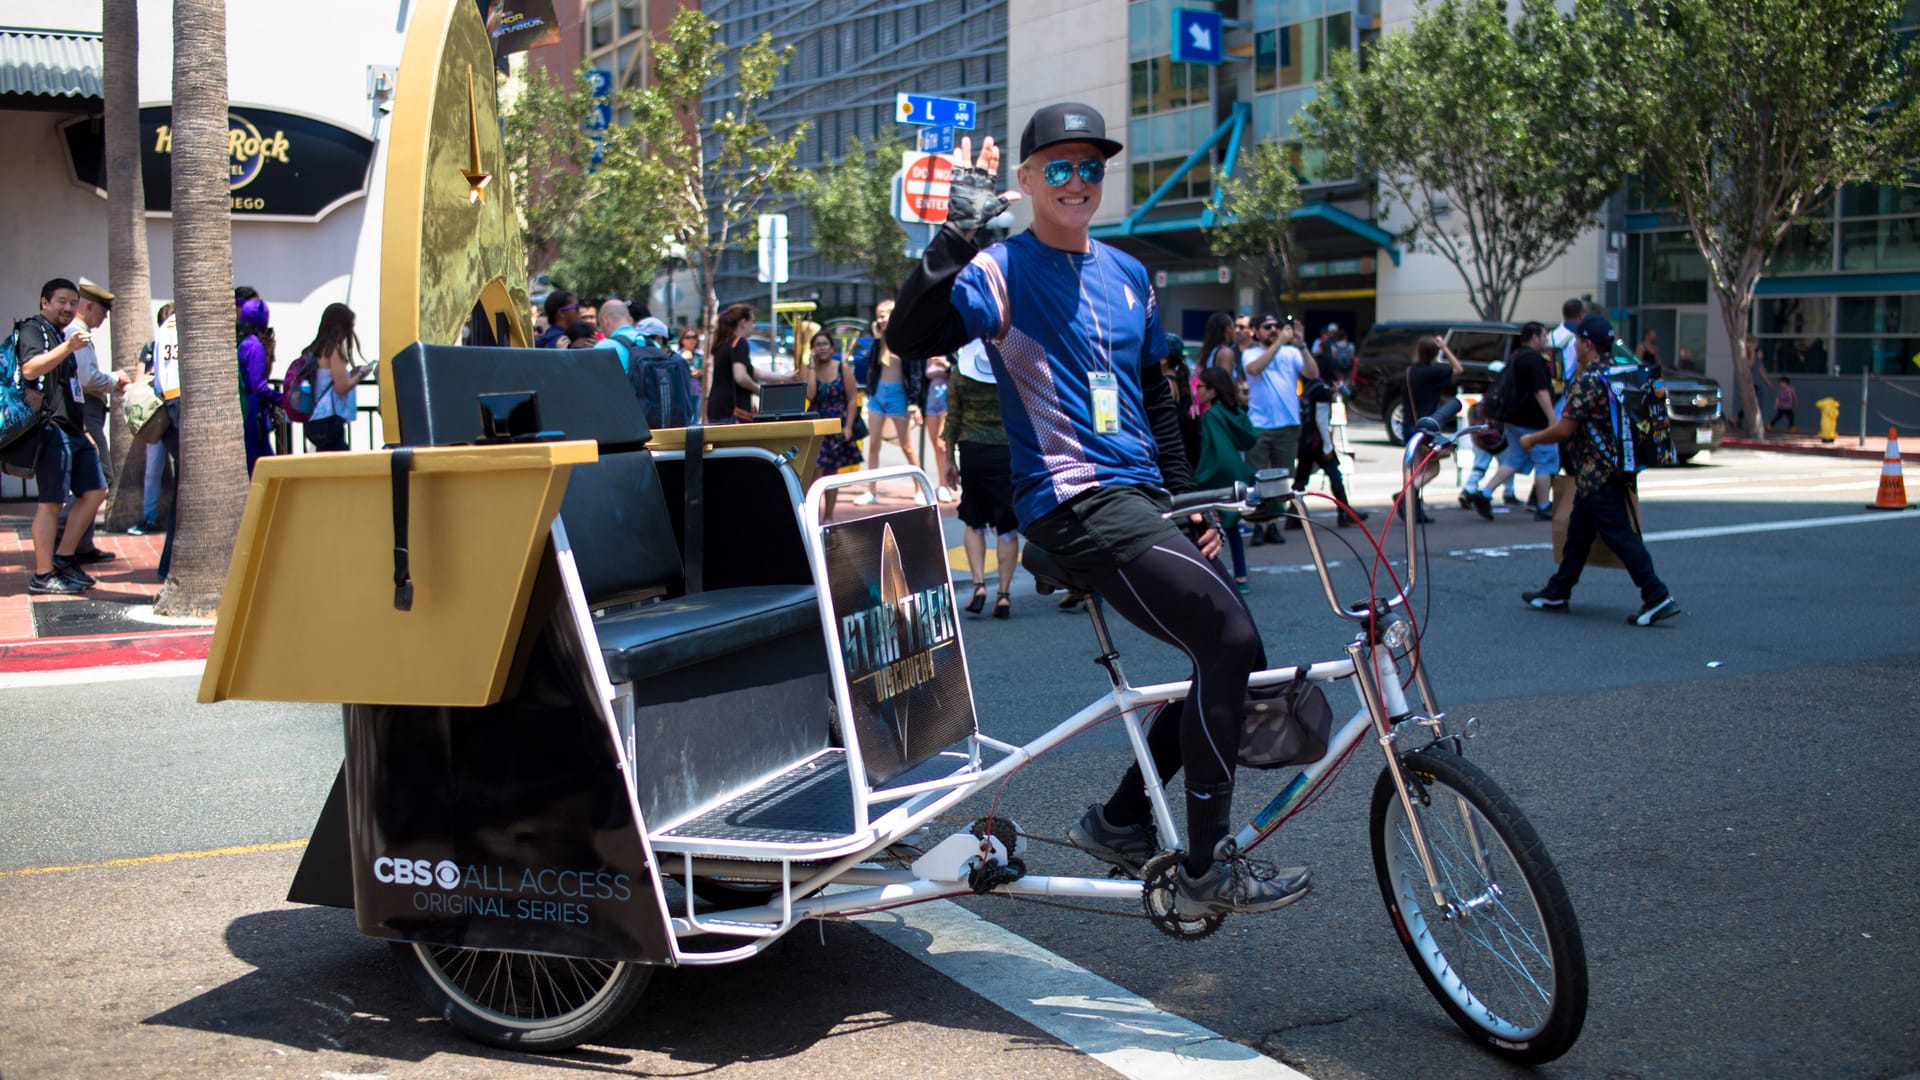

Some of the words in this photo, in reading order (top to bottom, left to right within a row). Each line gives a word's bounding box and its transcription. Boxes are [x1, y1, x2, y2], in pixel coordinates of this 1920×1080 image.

[926, 101, 935, 120] L
[229, 128, 290, 163] Rock
[911, 167, 929, 179] DO
[934, 168, 952, 181] NO
[229, 197, 265, 210] IEGO
[164, 344, 179, 361] 33
[842, 601, 901, 673] STAR
[899, 582, 954, 654] TREK
[874, 648, 936, 703] DISCOVERY
[374, 856, 433, 886] CBS
[462, 864, 513, 892] ALL
[519, 867, 632, 901] ACCESS
[413, 891, 511, 918] ORIGINAL
[517, 899, 590, 924] SERIES
